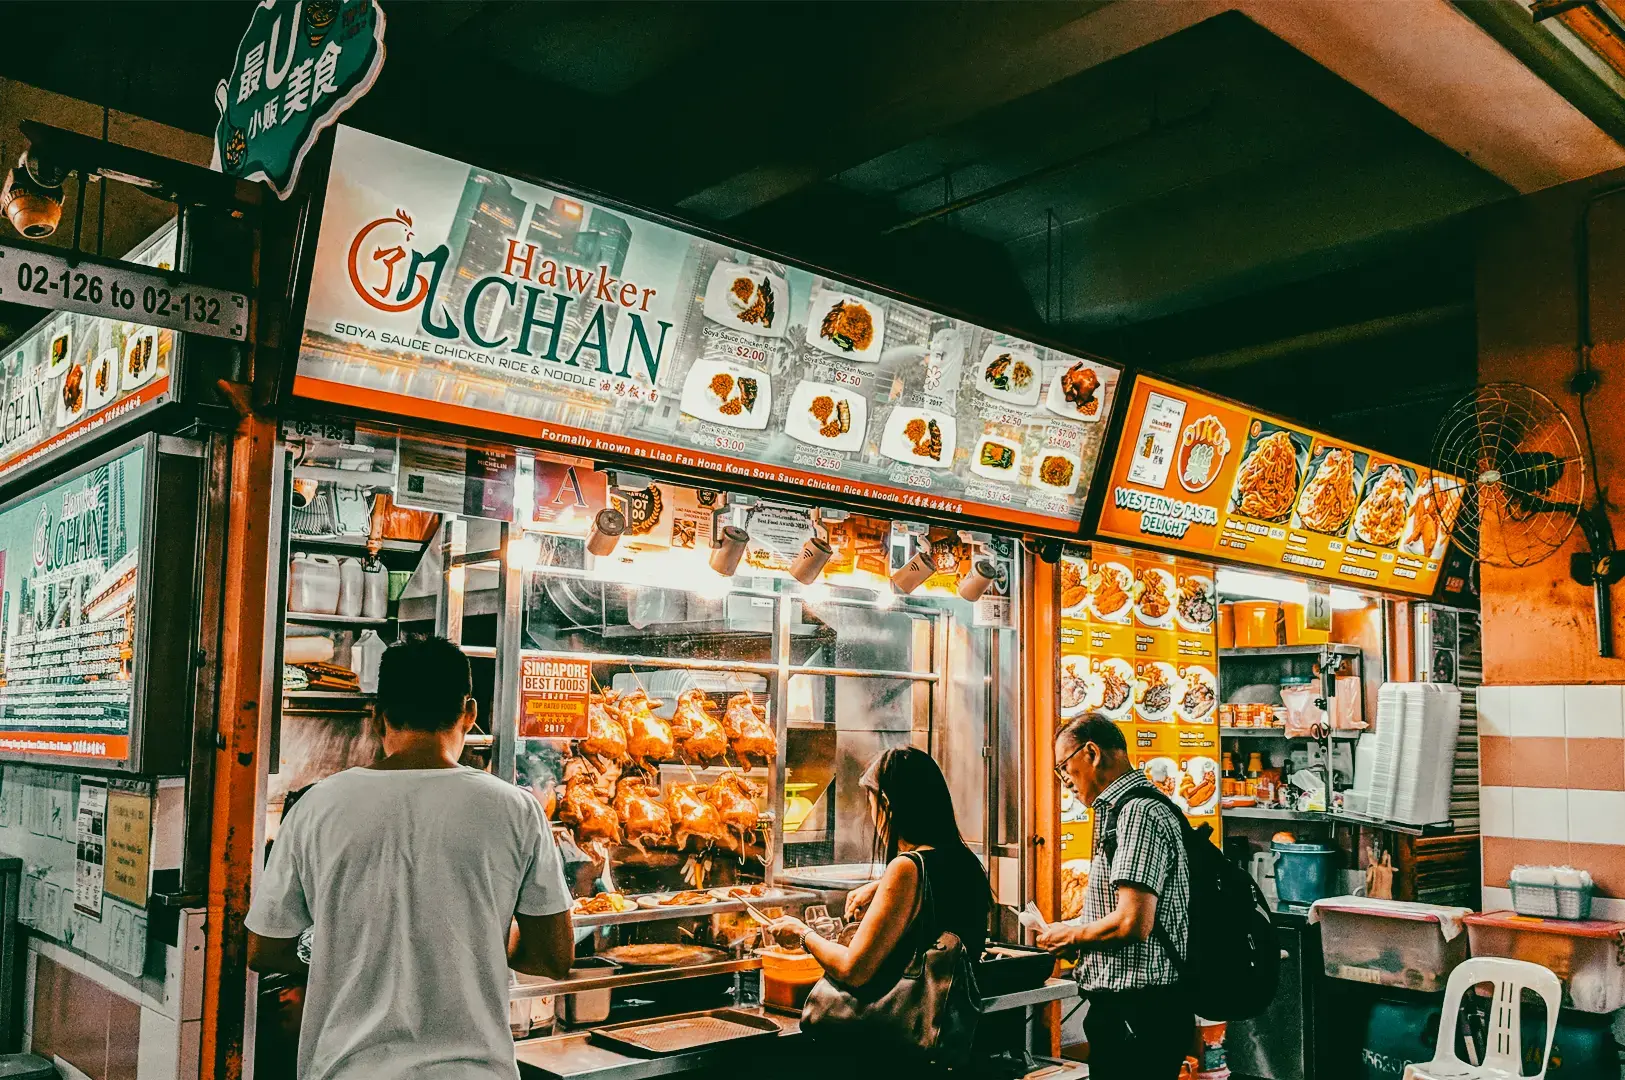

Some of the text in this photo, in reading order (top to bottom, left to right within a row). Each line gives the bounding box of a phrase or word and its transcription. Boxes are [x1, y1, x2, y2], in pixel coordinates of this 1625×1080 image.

[501, 238, 657, 313] Hawker
[17, 262, 222, 325] 02-126 to 02-132
[463, 275, 674, 386] CHAN
[703, 327, 719, 338] Soya
[720, 331, 739, 343] Sauce
[739, 337, 763, 349] Chicken
[764, 343, 777, 353] Rice
[334, 322, 597, 388] SOYA SAUCE CHICKEN RICE & NOODLE
[736, 346, 765, 361] $2.00
[804, 354, 876, 378] Soya Sauce Chicken Noodle
[835, 371, 861, 386] $2.50
[1001, 414, 1022, 426] $2.50
[1058, 428, 1077, 440] $7.00
[715, 437, 745, 451] $3.00
[477, 460, 508, 470] MICHELIN
[541, 428, 900, 503] Formally known as Liao Fan Hong Kong Soya Sauce Chicken Rice & Noodle
[815, 457, 841, 470] $2.50
[552, 466, 590, 508] A
[908, 475, 931, 487] $2.50
[632, 509, 646, 521] 00
[1115, 488, 1217, 523] WESTERN & PASTA
[1142, 513, 1188, 535] DELIGHT
[54, 505, 105, 570] CHAN
[1314, 594, 1324, 618] B
[523, 660, 589, 679] SINGAPORE
[525, 677, 585, 692] BEST FOODS
[542, 692, 569, 700] ENJOY
[544, 724, 565, 733] 2017
